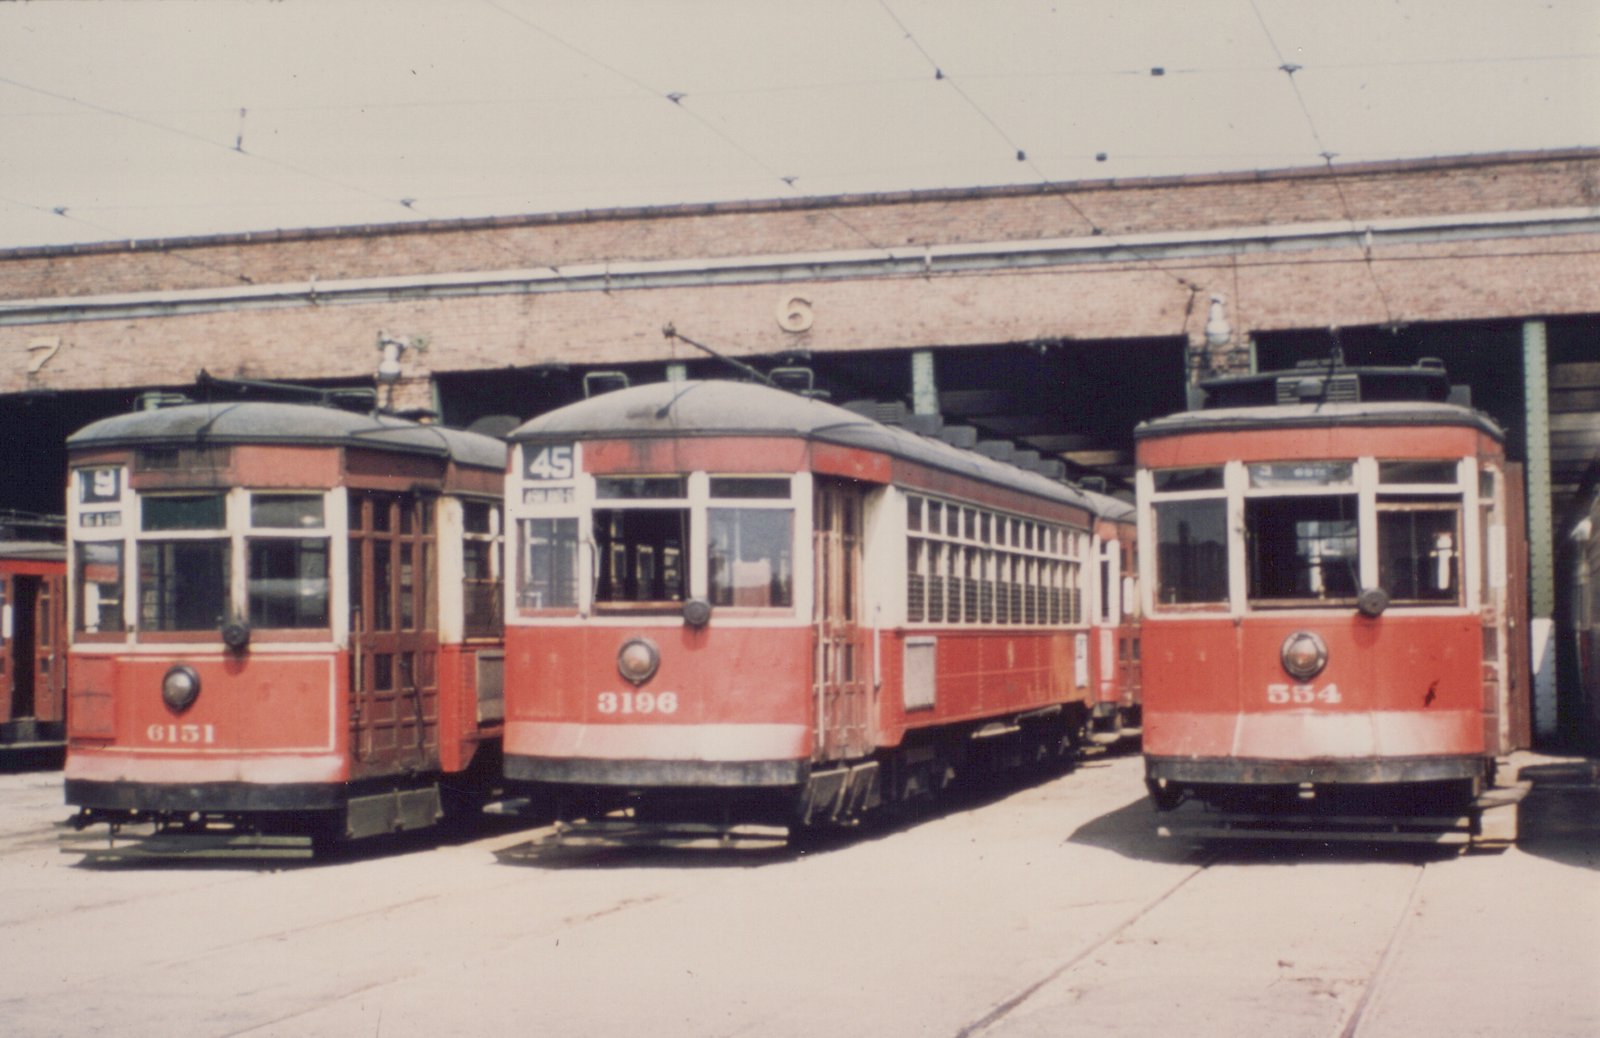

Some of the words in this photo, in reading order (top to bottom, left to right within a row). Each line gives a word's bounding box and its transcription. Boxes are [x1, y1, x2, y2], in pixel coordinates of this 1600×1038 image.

[777, 291, 813, 333] 6
[28, 335, 60, 373] 7
[529, 446, 572, 479] 45
[94, 469, 115, 496] 9
[597, 691, 678, 715] 3196
[1267, 683, 1342, 704] 554
[146, 724, 214, 743] 6151
